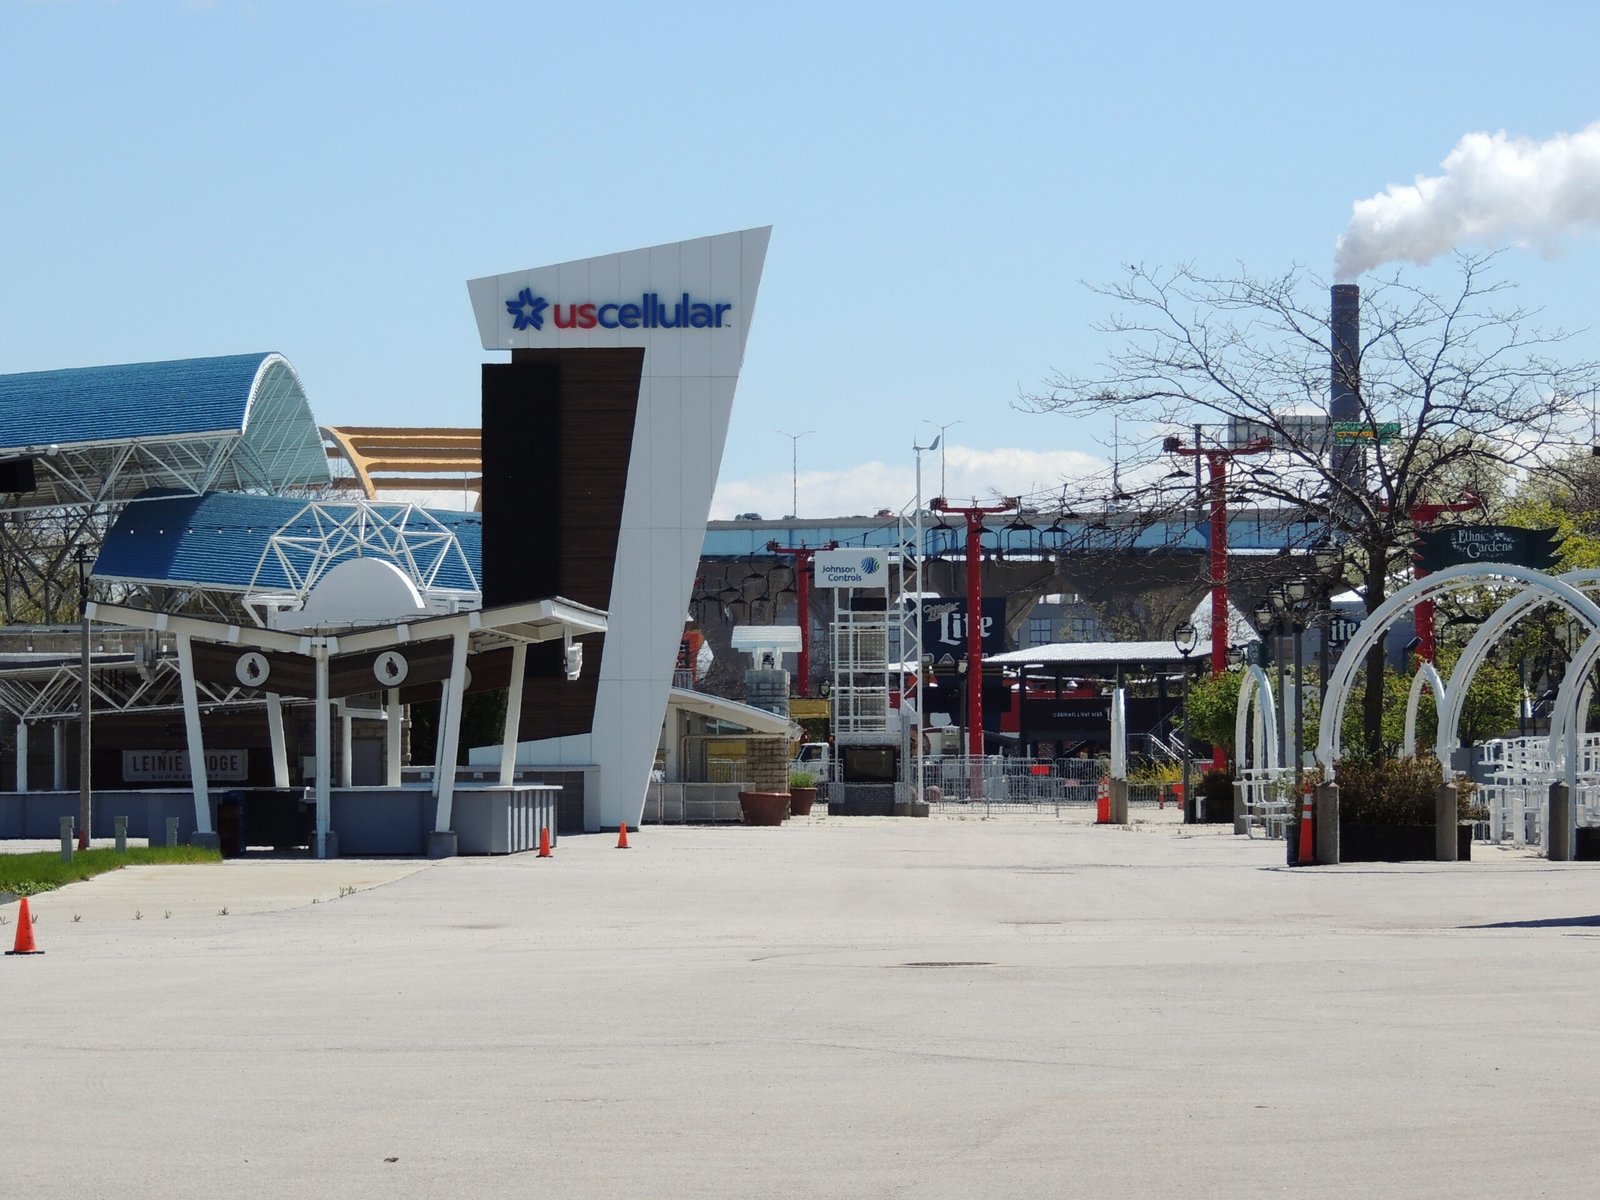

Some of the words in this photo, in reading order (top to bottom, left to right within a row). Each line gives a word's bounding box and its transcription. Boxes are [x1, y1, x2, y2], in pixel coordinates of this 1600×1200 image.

[1458, 529, 1490, 544] Ethnic
[1466, 540, 1513, 559] Gardens
[822, 565, 856, 574] Johnson
[828, 573, 862, 582] Controls
[1328, 619, 1357, 647] ite
[132, 755, 183, 772] LEINIE
